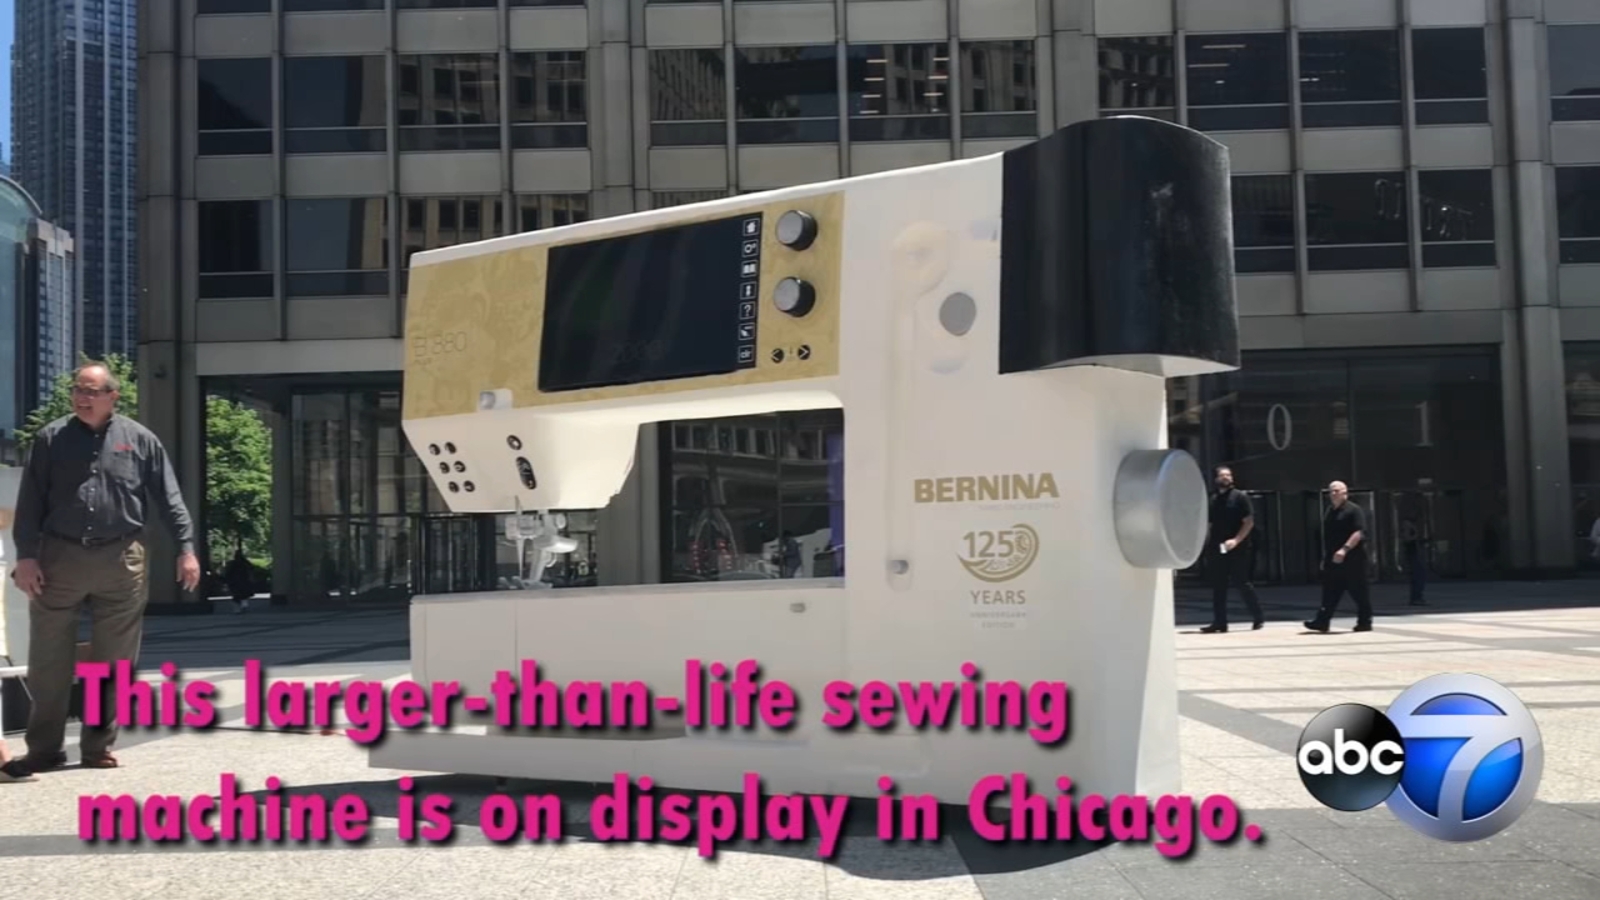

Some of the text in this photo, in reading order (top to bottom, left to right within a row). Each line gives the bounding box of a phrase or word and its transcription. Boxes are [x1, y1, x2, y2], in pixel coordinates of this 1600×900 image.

[431, 330, 467, 355] 880
[914, 472, 1060, 503] BERNINA
[962, 530, 1015, 559] 125
[970, 589, 1026, 605] YEARS
